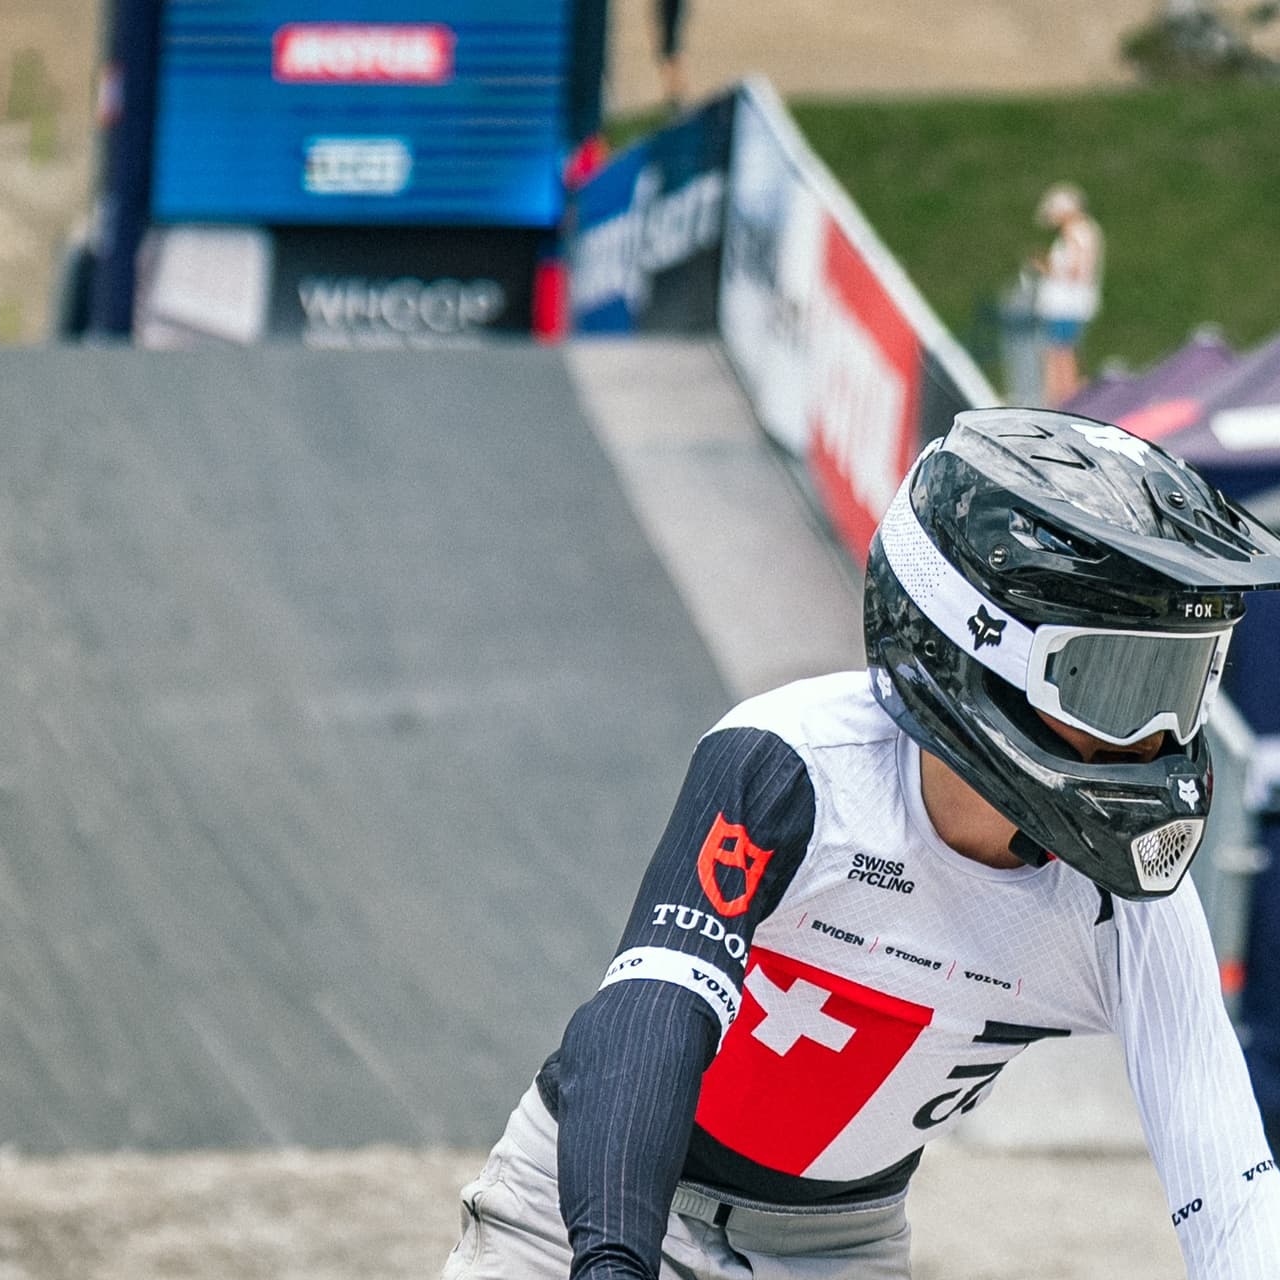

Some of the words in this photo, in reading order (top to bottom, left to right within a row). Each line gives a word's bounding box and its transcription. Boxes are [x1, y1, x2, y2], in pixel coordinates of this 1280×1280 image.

[1184, 603, 1213, 618] FOX
[852, 853, 904, 876] SWISS
[847, 868, 915, 894] CYCLING
[812, 919, 865, 946] EVIDEN
[895, 949, 932, 969] TUDOR
[963, 970, 1012, 990] VOLVO
